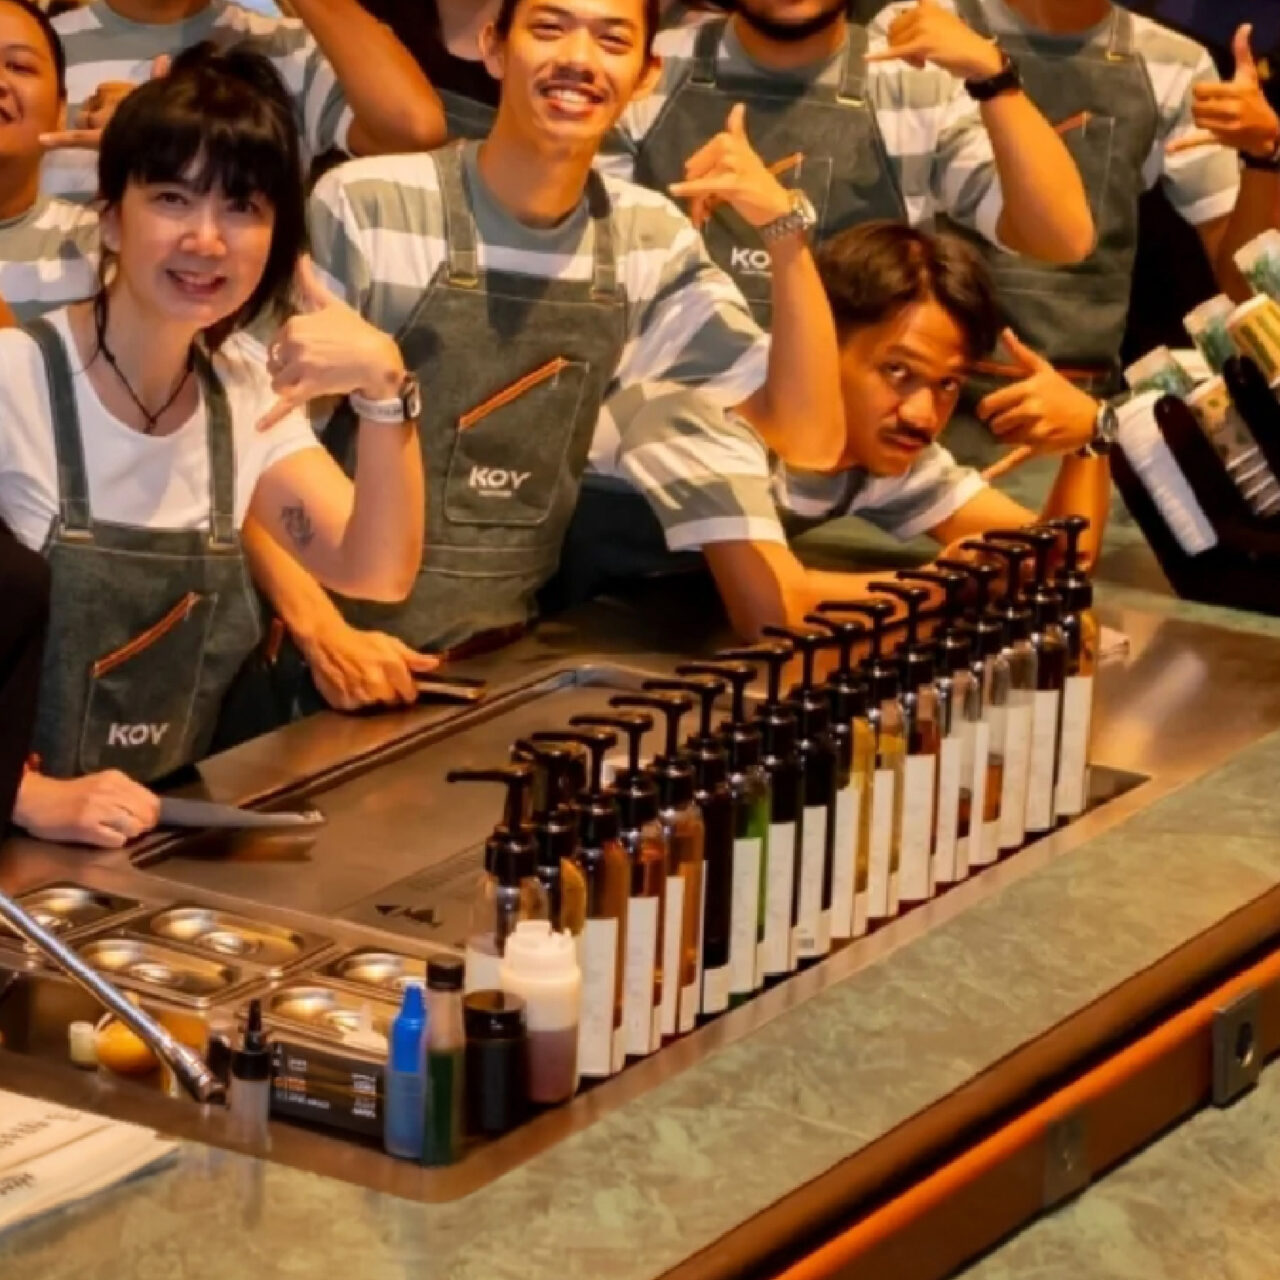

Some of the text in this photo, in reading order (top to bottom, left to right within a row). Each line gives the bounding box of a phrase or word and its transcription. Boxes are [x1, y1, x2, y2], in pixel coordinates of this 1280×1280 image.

[730, 245, 773, 270] KO
[469, 465, 532, 490] KOY
[107, 722, 170, 746] KOY
